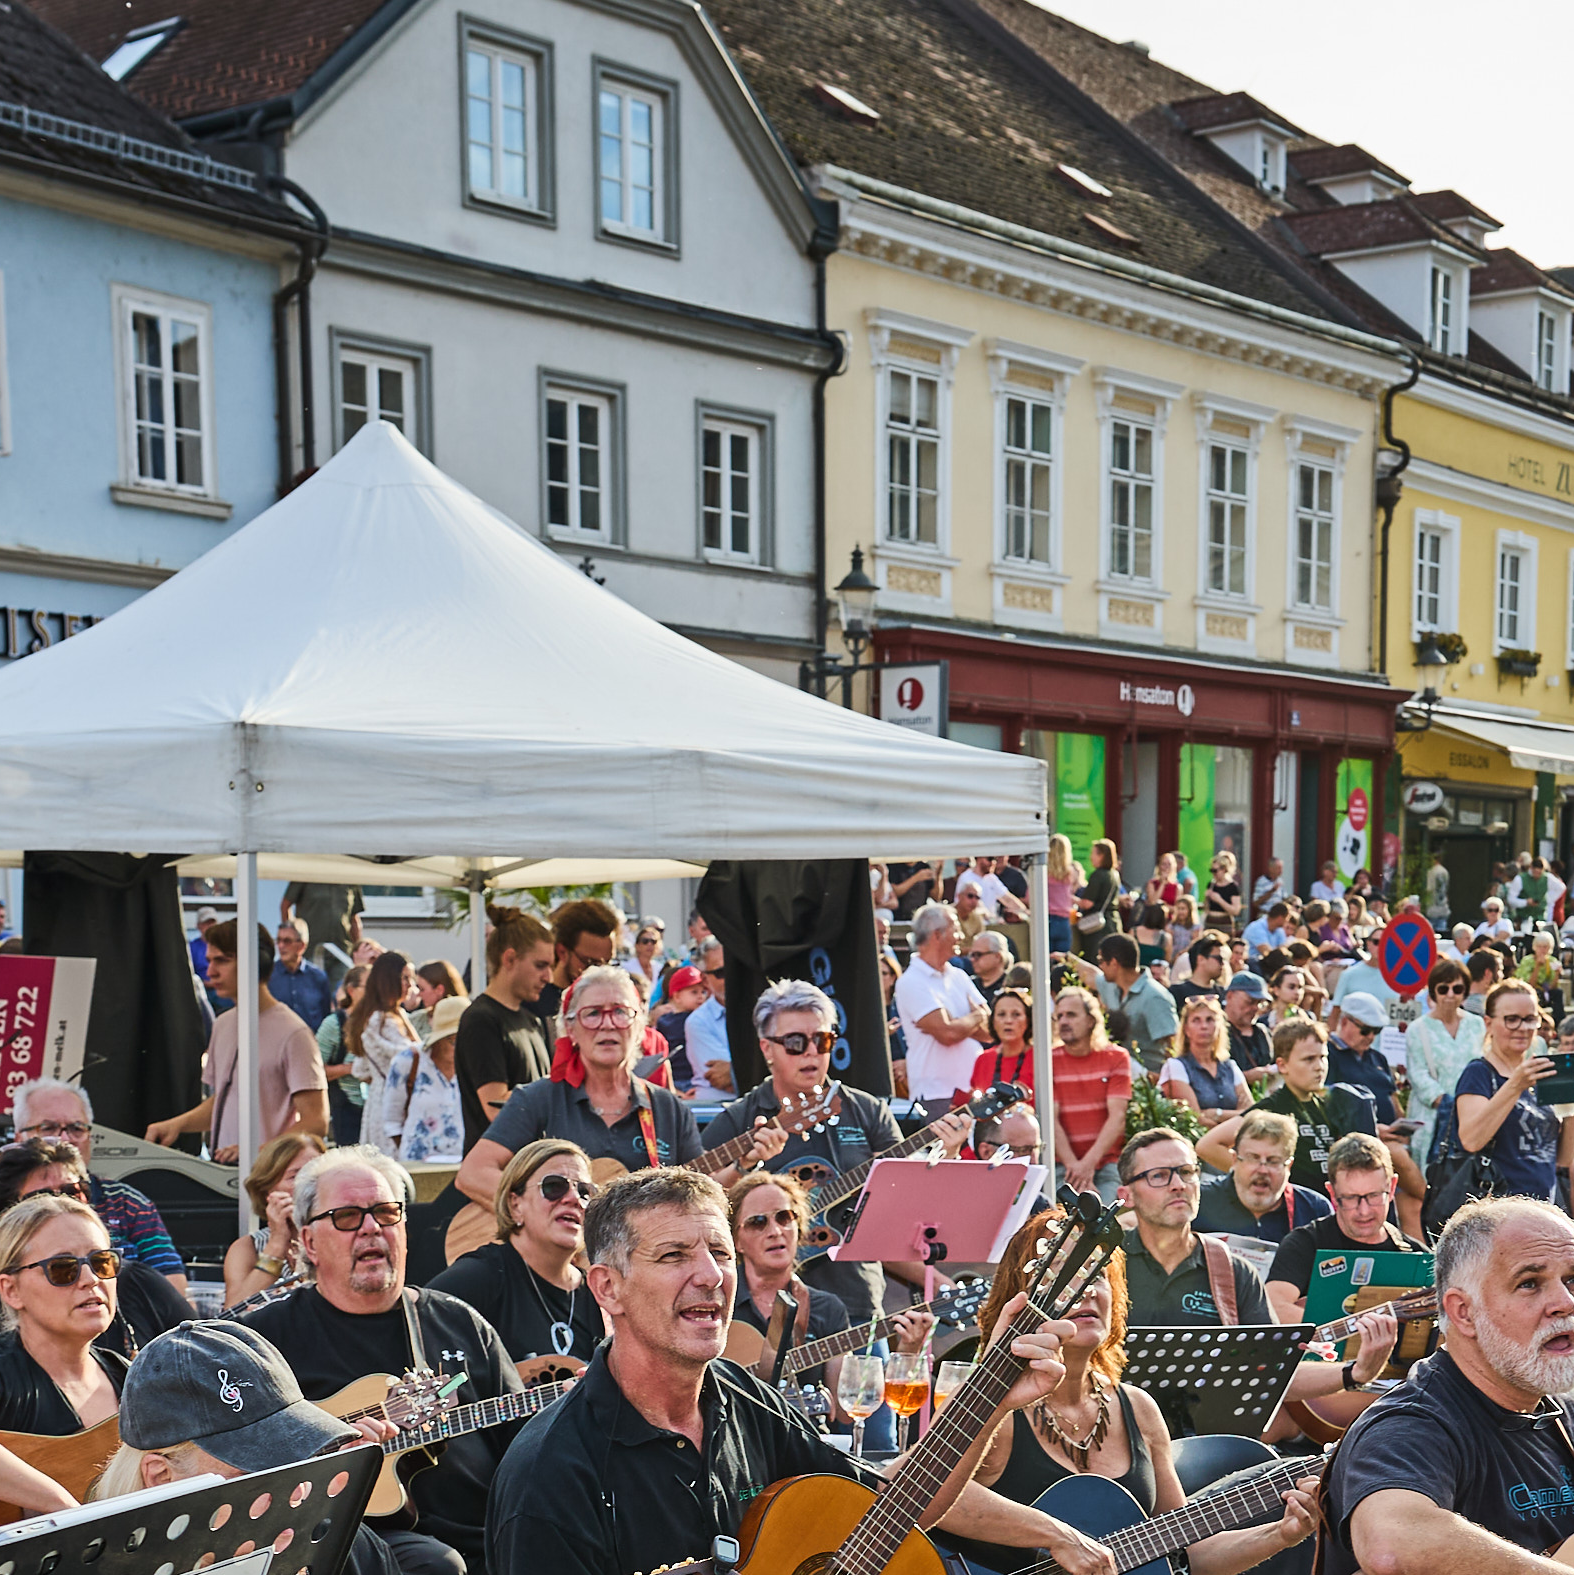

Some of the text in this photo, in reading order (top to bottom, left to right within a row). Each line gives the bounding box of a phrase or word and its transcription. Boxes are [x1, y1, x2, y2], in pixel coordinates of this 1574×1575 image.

[1509, 457, 1546, 486] HOTEL
[1119, 681, 1175, 707] Hnsaton
[14, 986, 40, 1029] 722
[1389, 1003, 1416, 1022] Ende
[16, 1034, 34, 1063] 68
